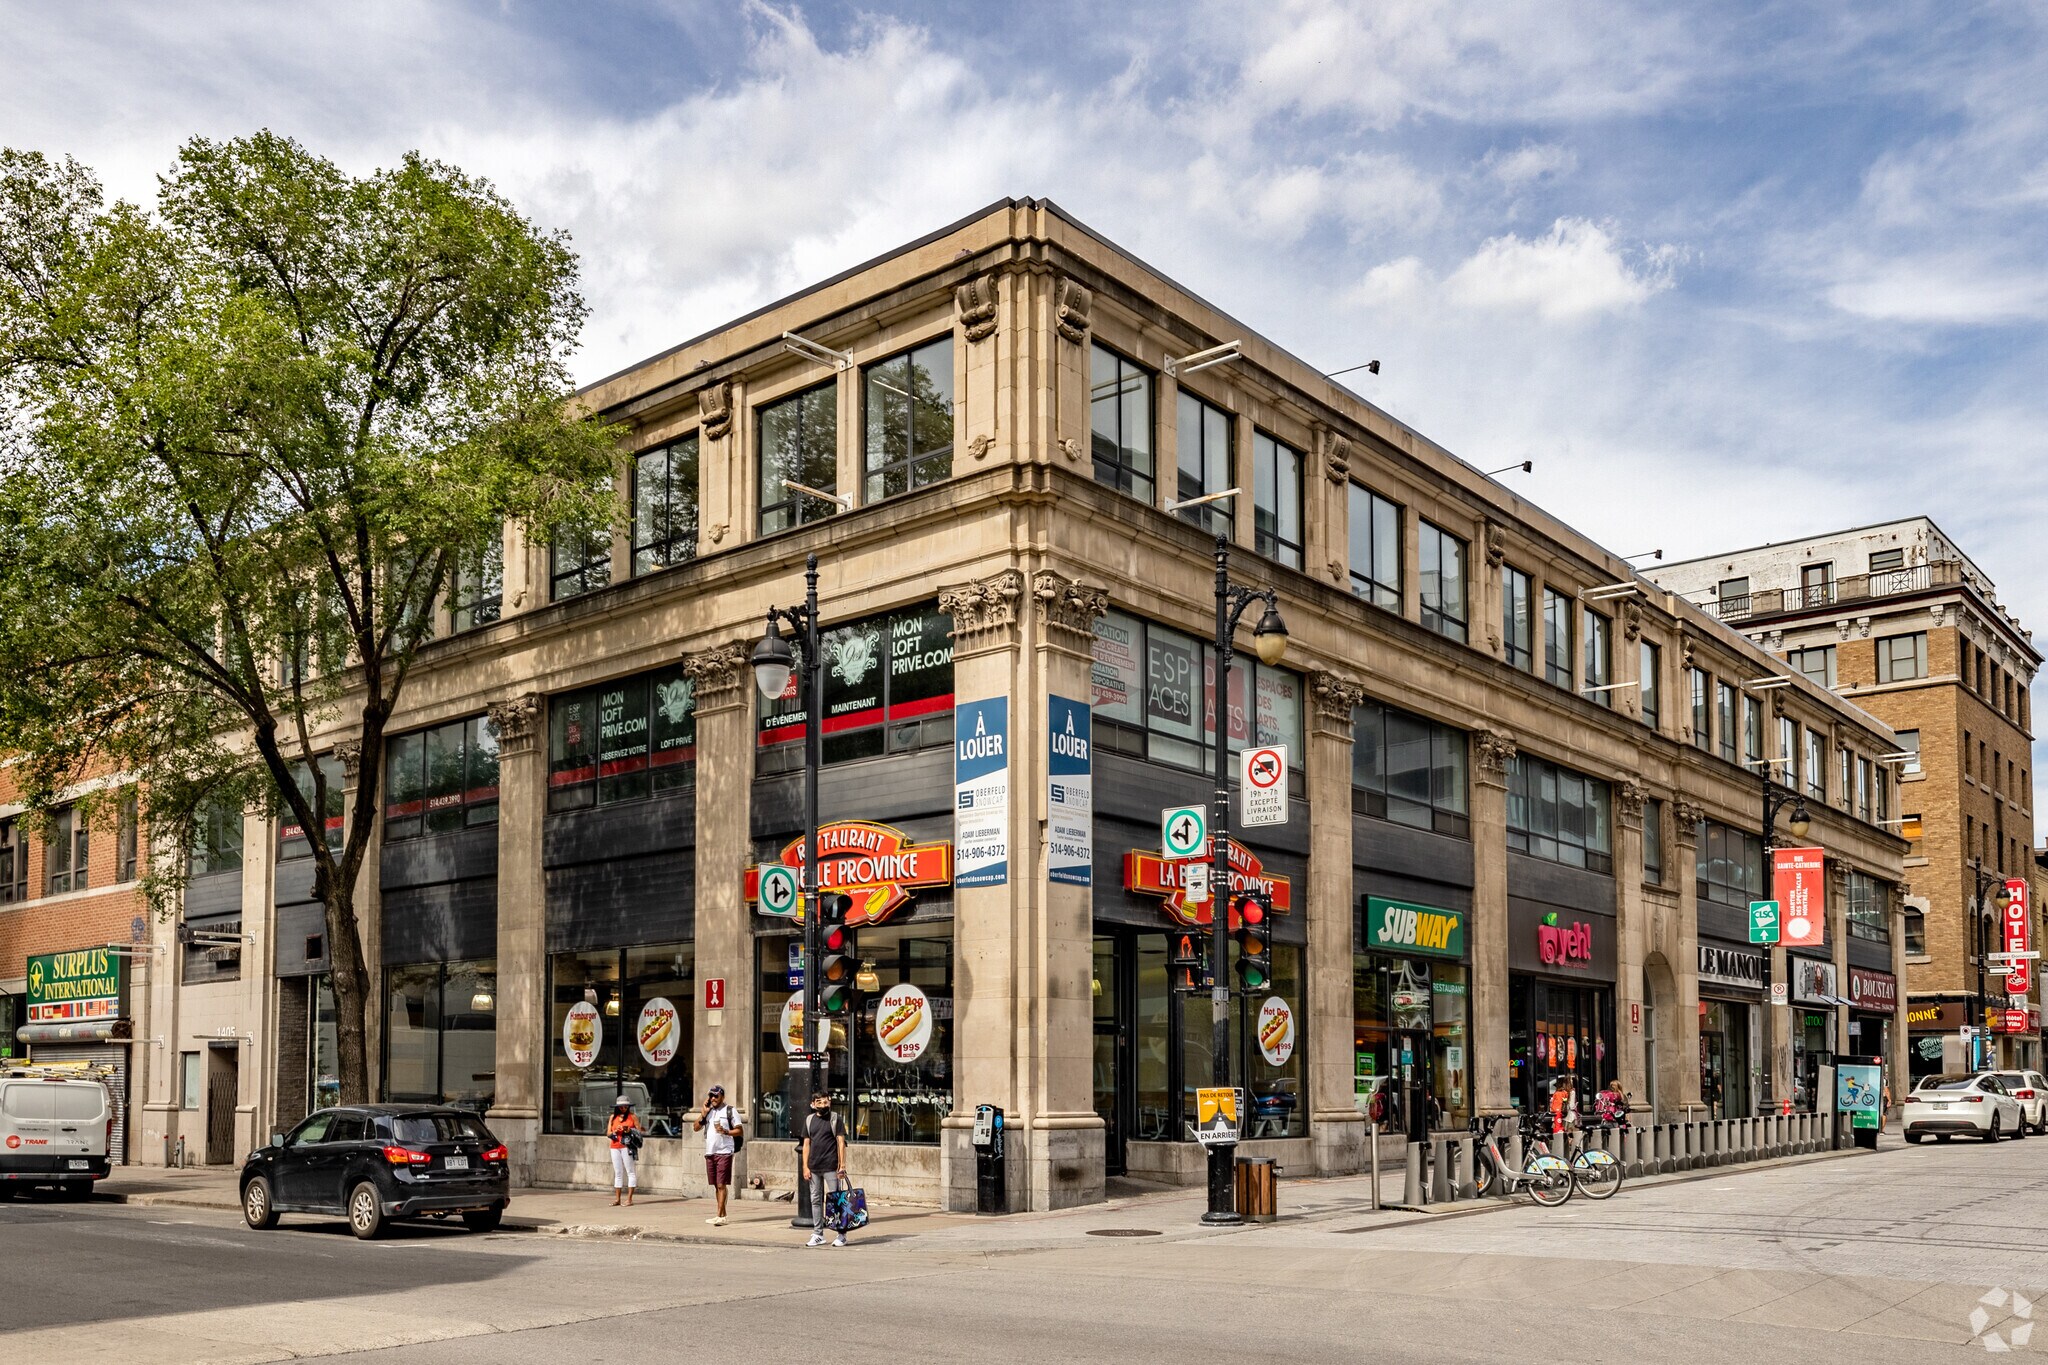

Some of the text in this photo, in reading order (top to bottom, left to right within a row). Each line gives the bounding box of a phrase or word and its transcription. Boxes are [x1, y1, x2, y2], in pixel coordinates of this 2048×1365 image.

[892, 617, 923, 638] MON
[892, 636, 922, 657] LOFT
[892, 647, 954, 675] PRIVE.COM
[1150, 646, 1190, 684] ESP
[602, 691, 624, 707] MON
[831, 697, 876, 713] MAINTENANT
[1149, 683, 1190, 717] ACES
[1258, 695, 1272, 710] DES
[602, 706, 624, 723] LOFT
[766, 711, 808, 727] D'ÉVÉNEMEN
[1065, 709, 1075, 735] À
[1205, 699, 1243, 731] ATS
[601, 717, 648, 739] PRIVE.COM
[975, 711, 986, 737] À
[629, 744, 647, 755] VOTRE
[661, 739, 675, 749] LOFT
[960, 734, 1003, 761] LOUER
[1052, 732, 1088, 760] LOUER
[976, 786, 1006, 797] OBERFELD
[1066, 786, 1089, 799] OBERFELD
[976, 795, 1003, 807] SNOWCAP
[1250, 797, 1278, 806] EXCEPTÉ
[1247, 806, 1282, 814] LIVRAISON
[1252, 814, 1277, 822] LOCALE
[962, 828, 1001, 839] ADAM LIEBERMAN
[1055, 826, 1086, 838] ADAM LIEBERMAN
[797, 828, 885, 871] RTAURANT
[957, 844, 1005, 861] 514-906-4372
[1050, 842, 1090, 859] 514-906-4372
[838, 853, 918, 884] PROVINCE
[1050, 871, 1090, 882] oberfeldsnowcap.com
[1160, 862, 1175, 887] LA
[956, 874, 1005, 885] oberfeldsnowcap.com
[1378, 906, 1458, 950] SUBWAY
[1556, 921, 1591, 966] yeh!
[53, 948, 109, 979] SURPLUS
[1716, 950, 1762, 981] MANOI
[45, 977, 117, 1000] INTERNATIONAL
[1433, 982, 1465, 994] RESTAURANT
[1863, 979, 1895, 999] BOUSTAN
[885, 997, 902, 1007] Hot
[905, 996, 923, 1008] Dog
[570, 1011, 597, 1022] Hamburger
[644, 1008, 673, 1019] Hot Dog
[1264, 1007, 1289, 1020] Hot Dog
[217, 1026, 236, 1038] 1405
